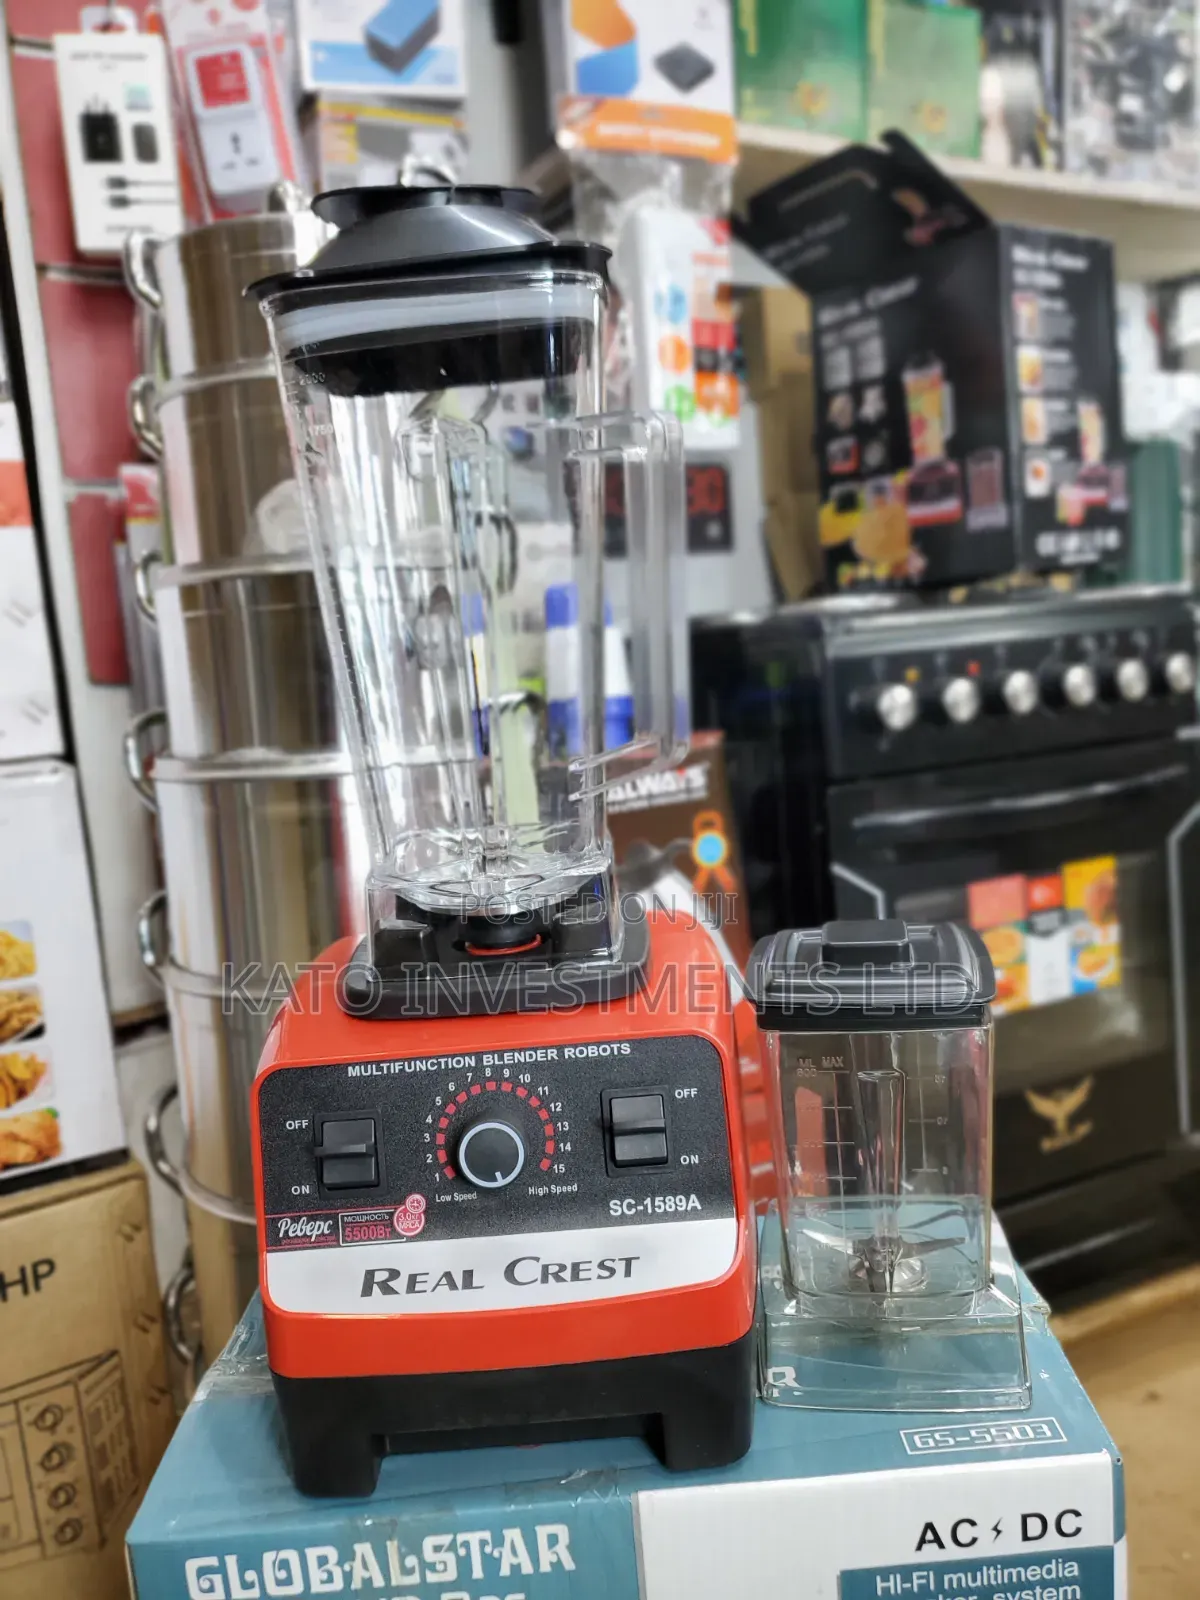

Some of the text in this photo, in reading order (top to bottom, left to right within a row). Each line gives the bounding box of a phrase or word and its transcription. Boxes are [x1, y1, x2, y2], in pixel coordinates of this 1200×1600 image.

[347, 1043, 631, 1077] MULTIFUNCTION BLENDER ROBOTS
[466, 1073, 473, 1082] 7
[485, 1068, 491, 1077] 8
[503, 1068, 510, 1078] 9
[518, 1073, 531, 1083] 10
[448, 1082, 455, 1091] 6
[537, 1086, 549, 1096] 11
[675, 1088, 698, 1099] OFF
[435, 1096, 442, 1106] 5
[549, 1102, 562, 1112] 12
[285, 1119, 309, 1130] OFF
[425, 1115, 432, 1124] 4
[556, 1122, 569, 1131] 13
[424, 1133, 430, 1143] 3
[558, 1142, 572, 1152] 14
[426, 1154, 433, 1163] 2
[680, 1154, 699, 1165] ON
[552, 1164, 565, 1174] 15
[434, 1173, 440, 1182] 1
[291, 1185, 310, 1195] ON
[528, 1183, 578, 1196] High Speed
[435, 1191, 477, 1202] Low Speed
[609, 1194, 702, 1216] SC-1589A
[278, 1216, 333, 1242] Реверс
[360, 1256, 641, 1298] REAL CREST
[913, 1422, 1052, 1449] GS-5503
[915, 1508, 1083, 1552] AC DC
[185, 1524, 577, 1600] GLOBALSTAR
[875, 1558, 1079, 1597] HI-FI multimedia
